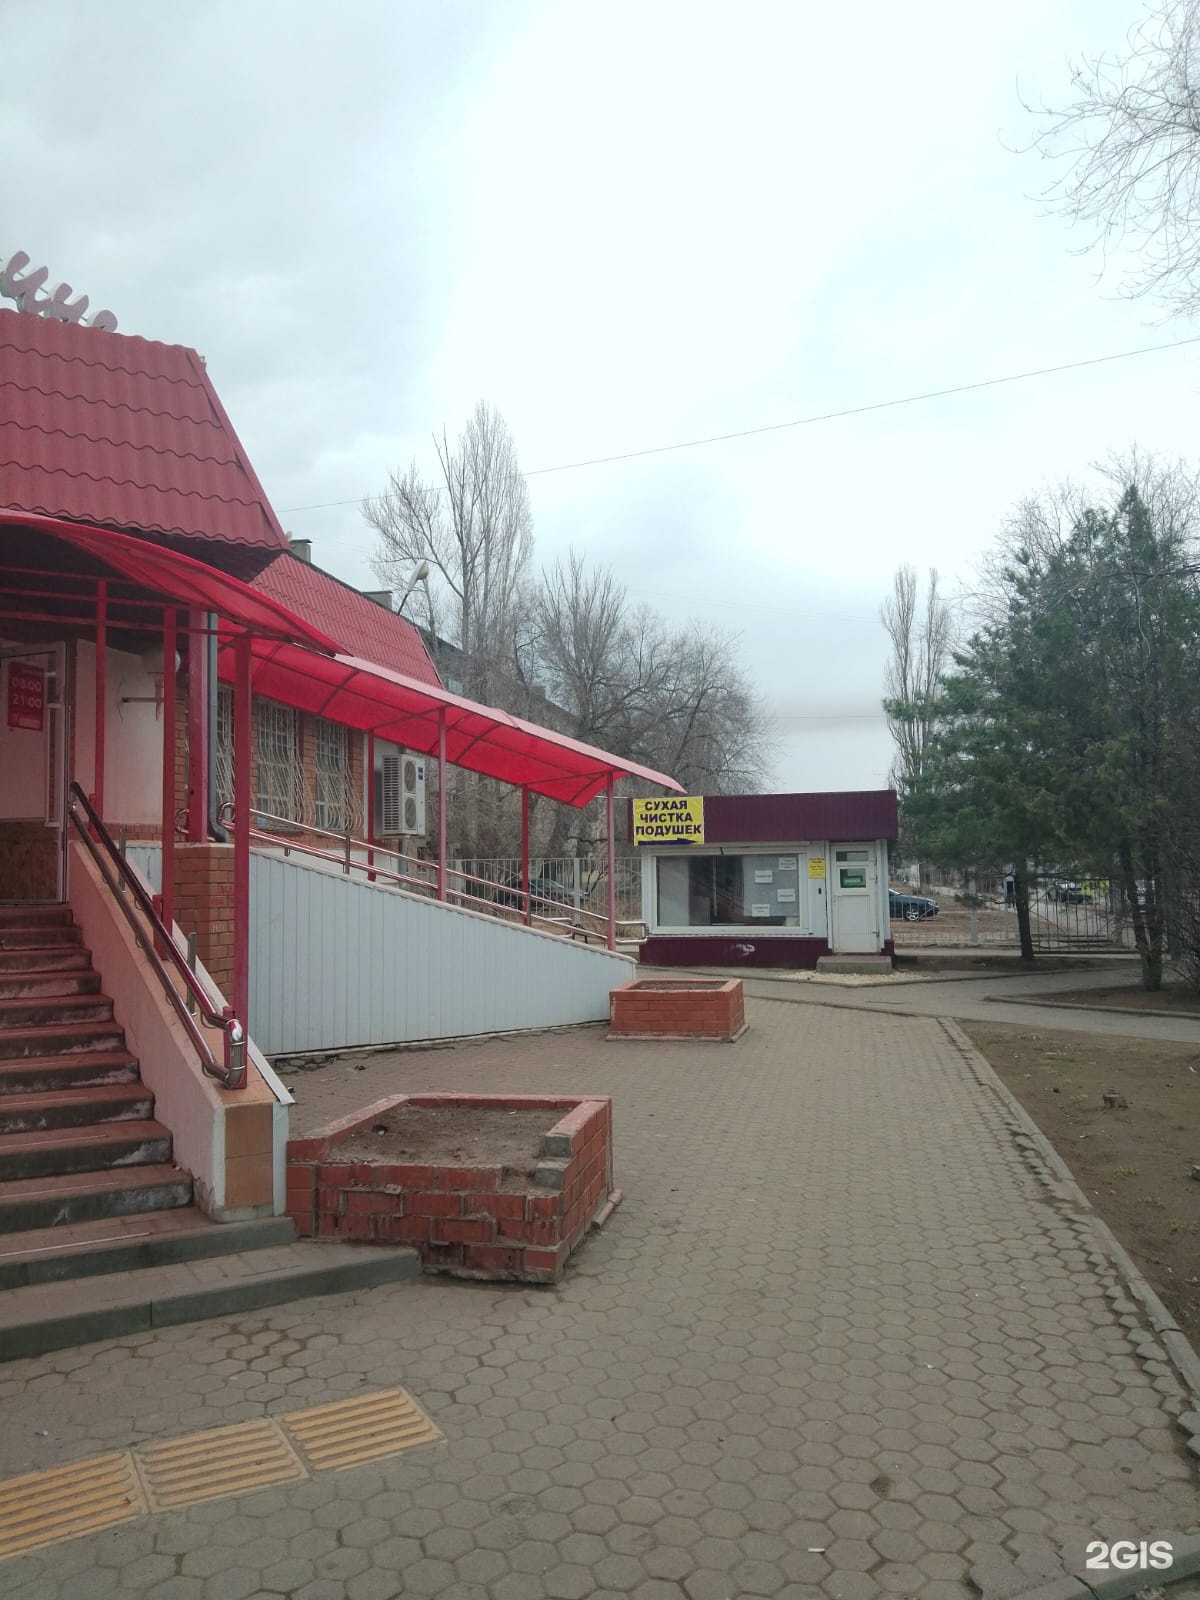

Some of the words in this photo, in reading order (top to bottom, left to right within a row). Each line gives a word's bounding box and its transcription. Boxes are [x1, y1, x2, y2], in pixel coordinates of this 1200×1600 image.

[644, 800, 688, 811] СУХАЯ
[640, 812, 693, 823] ЧИСТКА
[635, 824, 702, 836] ПОДУШЕК
